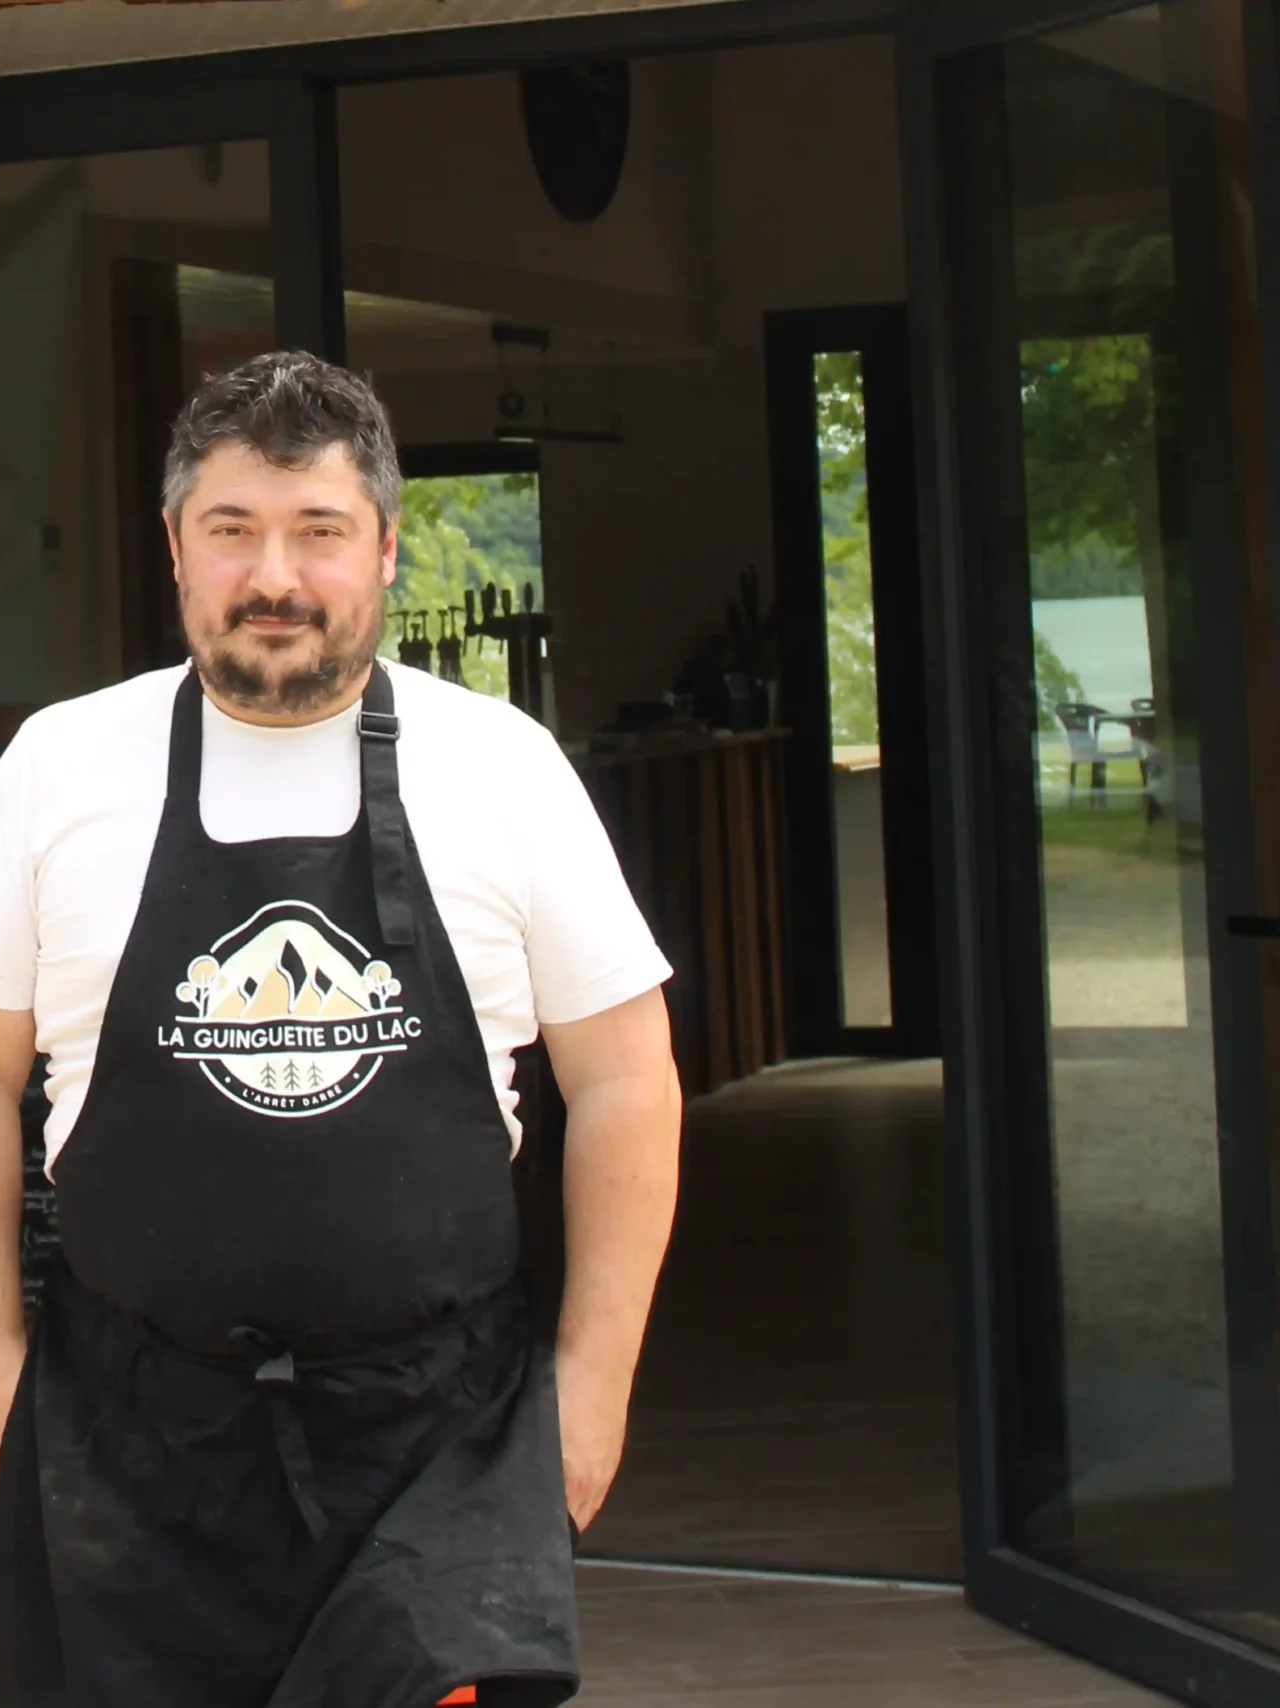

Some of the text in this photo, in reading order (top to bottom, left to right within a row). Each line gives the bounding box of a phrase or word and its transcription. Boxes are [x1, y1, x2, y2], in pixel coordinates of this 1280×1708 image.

[158, 1016, 421, 1048] LA GUINGUETTE DU LAC
